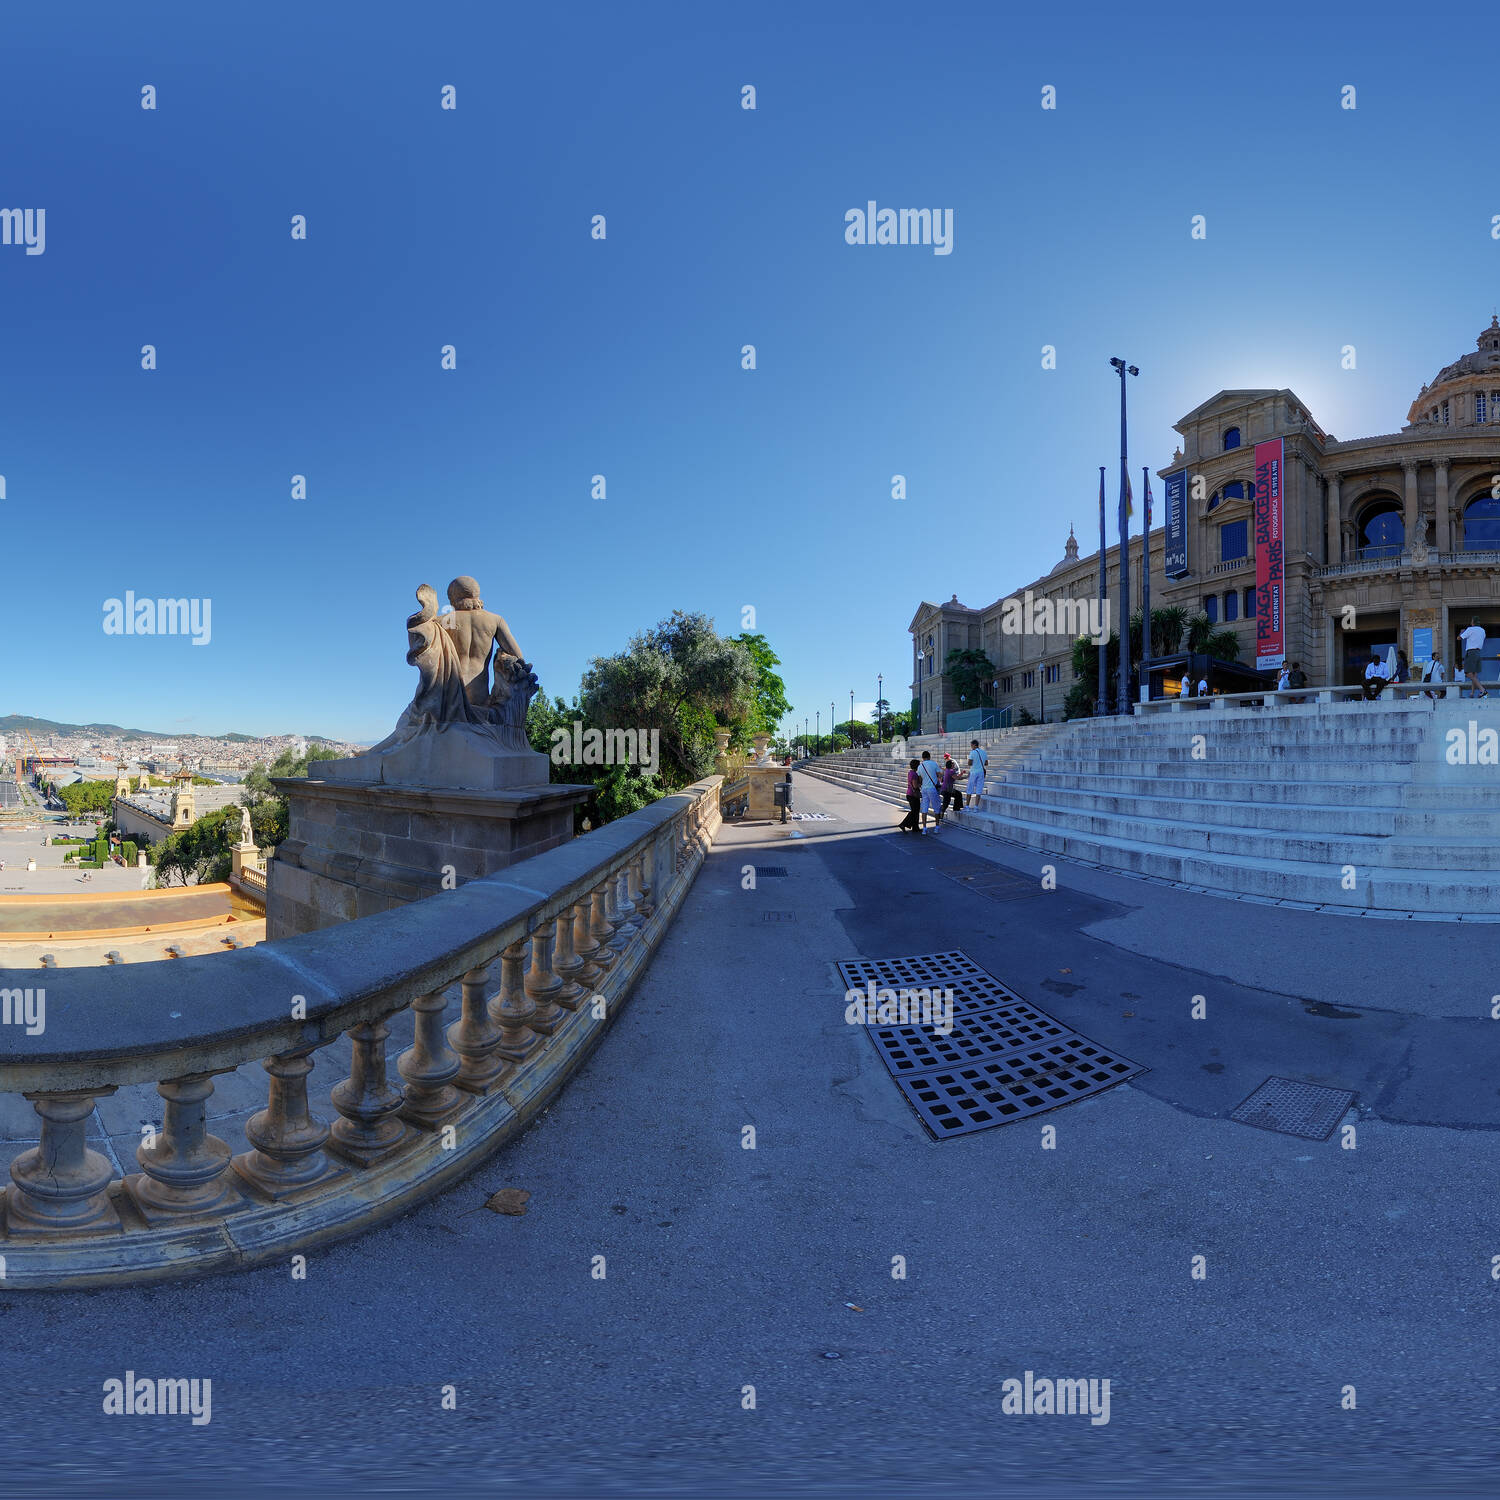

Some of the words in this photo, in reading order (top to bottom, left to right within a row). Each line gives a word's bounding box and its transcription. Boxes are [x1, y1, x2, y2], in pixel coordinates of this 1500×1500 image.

[1256, 461, 1269, 544] BARCELONA
[1265, 540, 1282, 581] PARÍS
[1257, 581, 1270, 640] PRAGA
